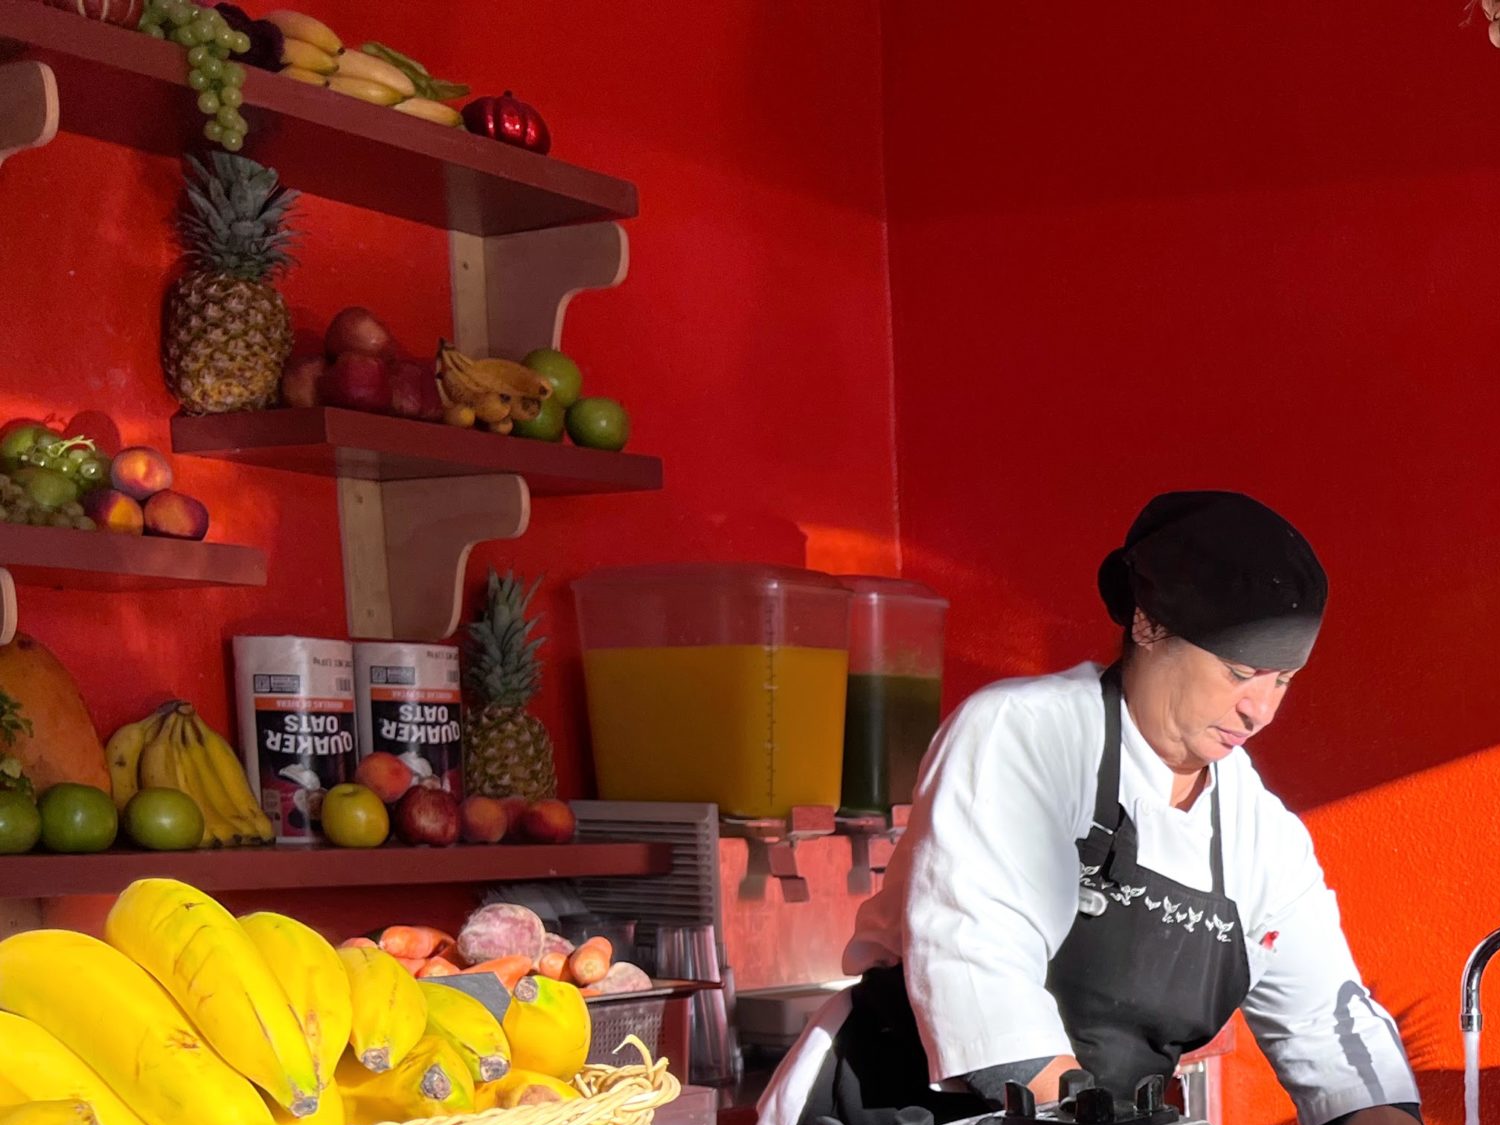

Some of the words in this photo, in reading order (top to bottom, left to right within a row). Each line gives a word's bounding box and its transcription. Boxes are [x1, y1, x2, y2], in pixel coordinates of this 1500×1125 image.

[284, 715, 338, 733] OATS
[400, 705, 448, 723] OATS
[381, 719, 460, 744] QUAKER
[266, 730, 353, 755] QUAKER
